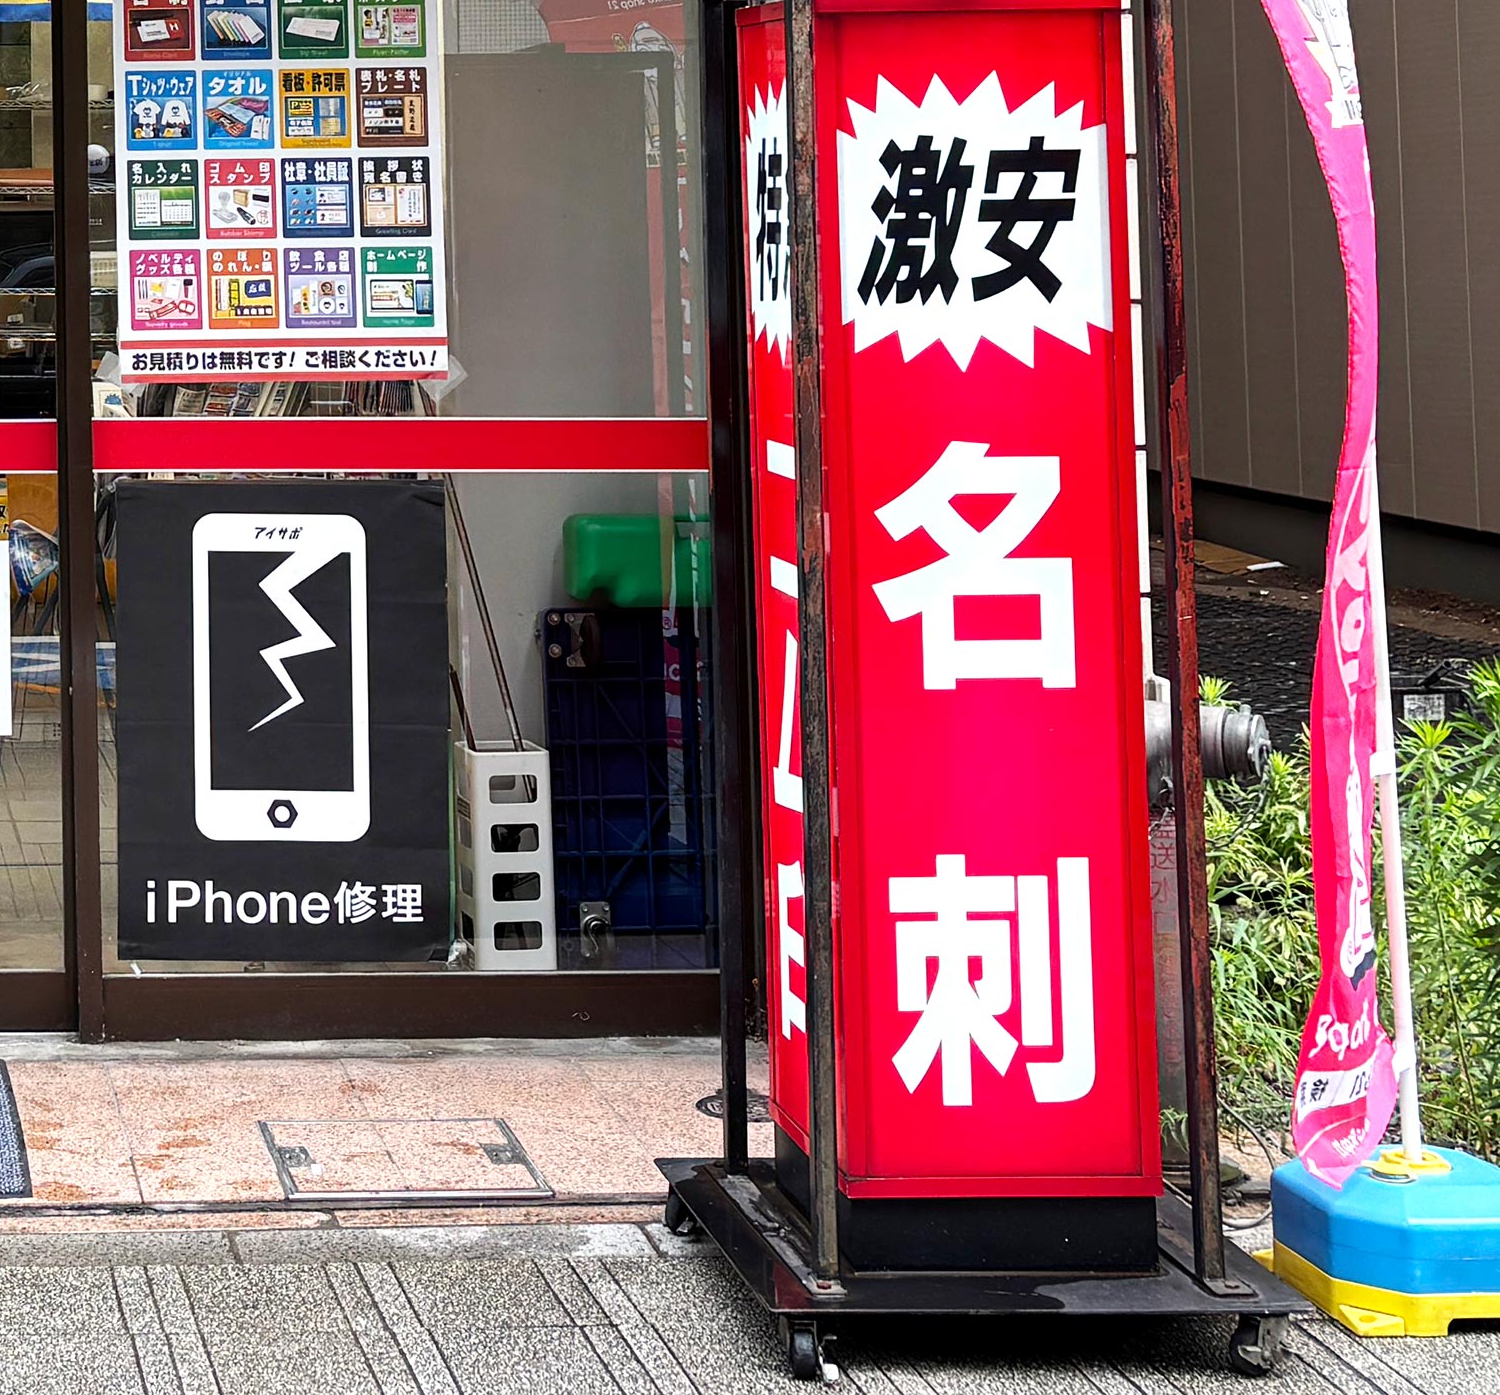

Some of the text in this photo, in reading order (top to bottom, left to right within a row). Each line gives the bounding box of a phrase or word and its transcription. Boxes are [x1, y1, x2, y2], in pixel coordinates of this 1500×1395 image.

[209, 76, 267, 96] タオル
[360, 81, 421, 93] プレート
[132, 162, 192, 173] 名入れ
[210, 162, 270, 173] ゴム印
[132, 173, 192, 185] カレンダー
[209, 173, 270, 184] スタンプ
[755, 136, 791, 303] 特
[858, 134, 1080, 306] 激安
[135, 254, 193, 264] ノベルティ
[366, 250, 427, 261] ホームページ
[132, 349, 437, 371] お見積りは無料です! ご相談ください!
[254, 525, 304, 541] アイサポ
[871, 439, 1097, 1107] 名刺
